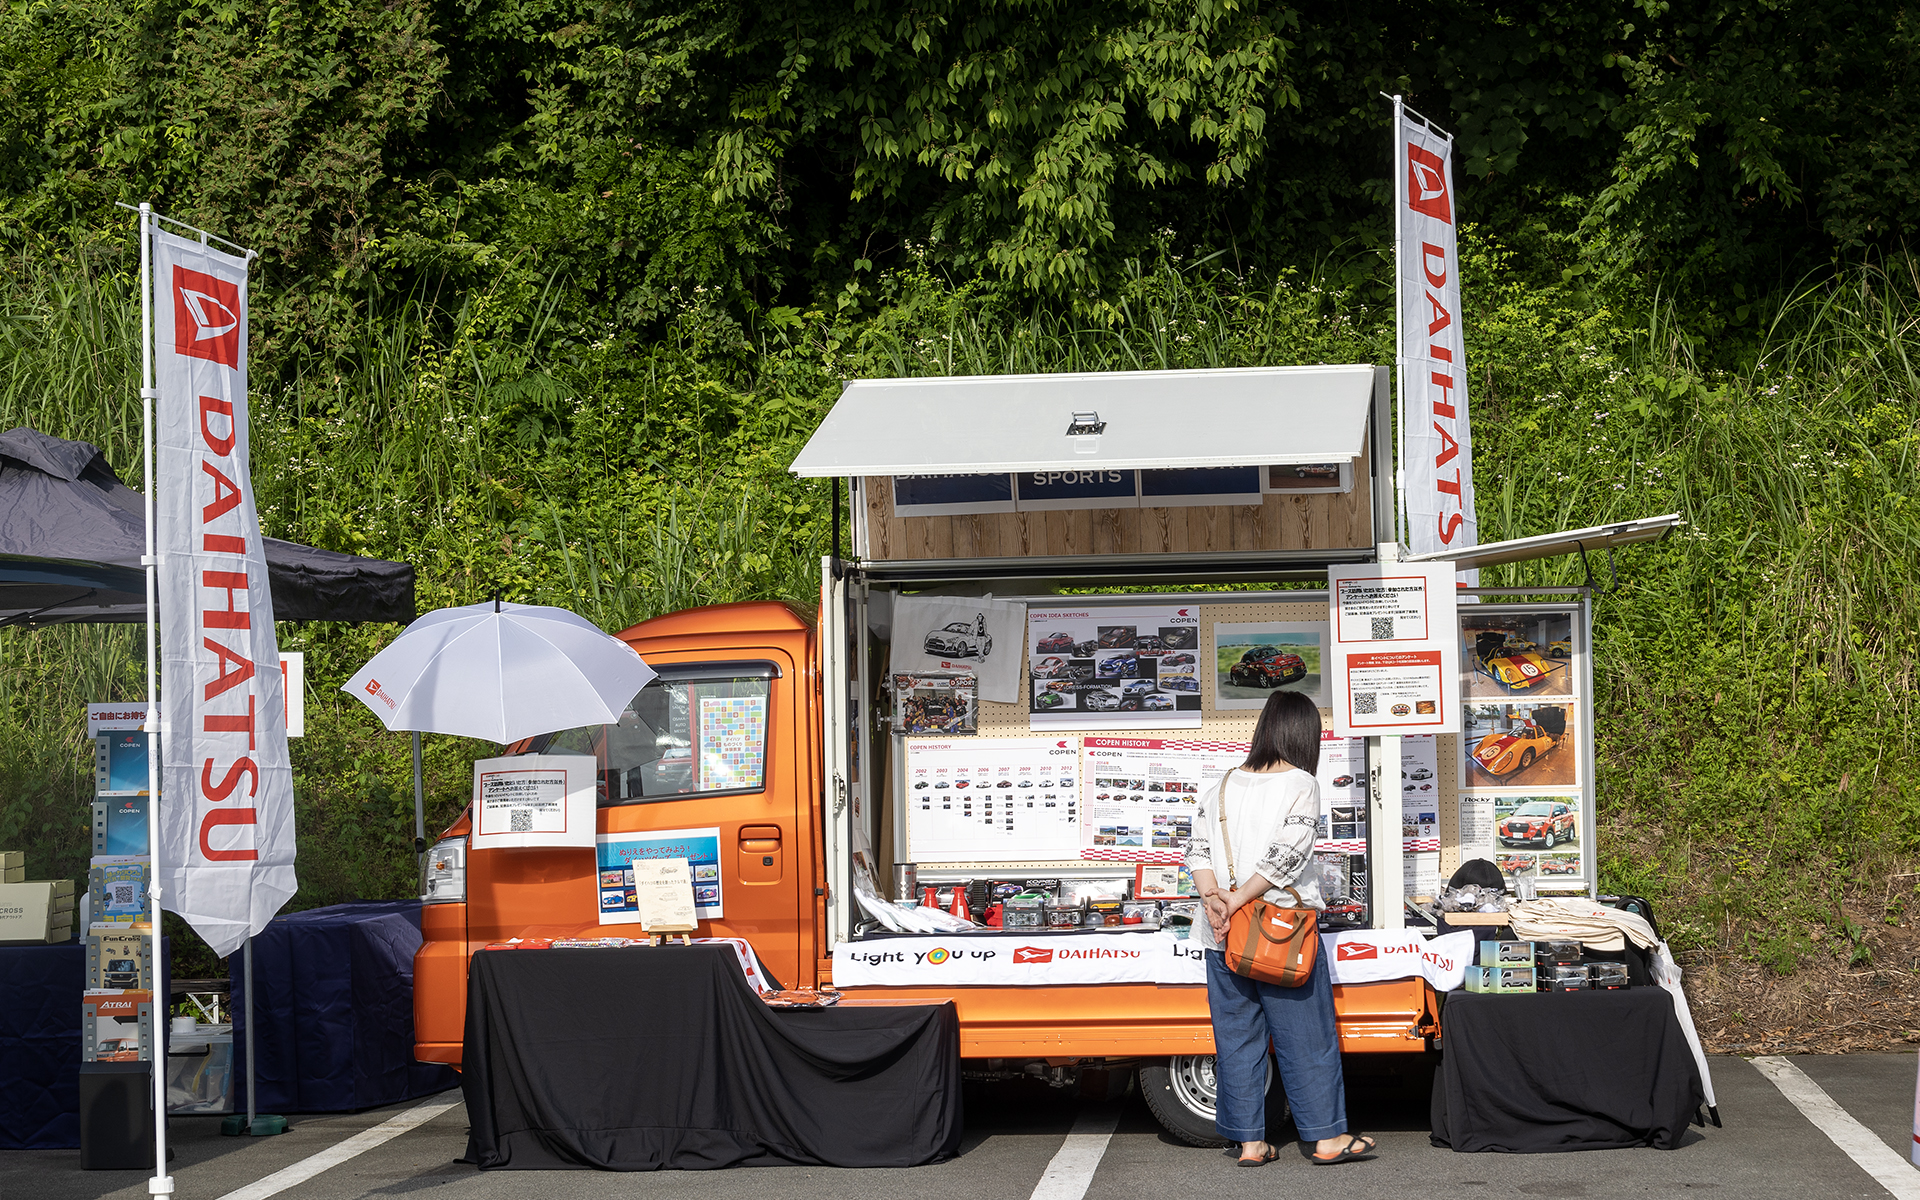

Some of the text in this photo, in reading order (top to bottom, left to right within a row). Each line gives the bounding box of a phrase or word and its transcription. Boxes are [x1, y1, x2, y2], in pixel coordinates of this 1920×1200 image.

[1422, 241, 1463, 551] DAIHATS
[1033, 470, 1122, 485] SPORTS
[199, 395, 259, 861] DAIHATSU
[376, 688, 397, 710] DAIHATSU
[91, 711, 161, 721] ご自由にお持ち
[1122, 739, 1151, 747] HISTORY
[619, 845, 690, 856] ぬりえをやってみよう!
[851, 951, 905, 966] Light
[971, 950, 997, 961] up
[1058, 947, 1141, 960] DAIHATSU
[100, 1001, 132, 1010] ATRAI
